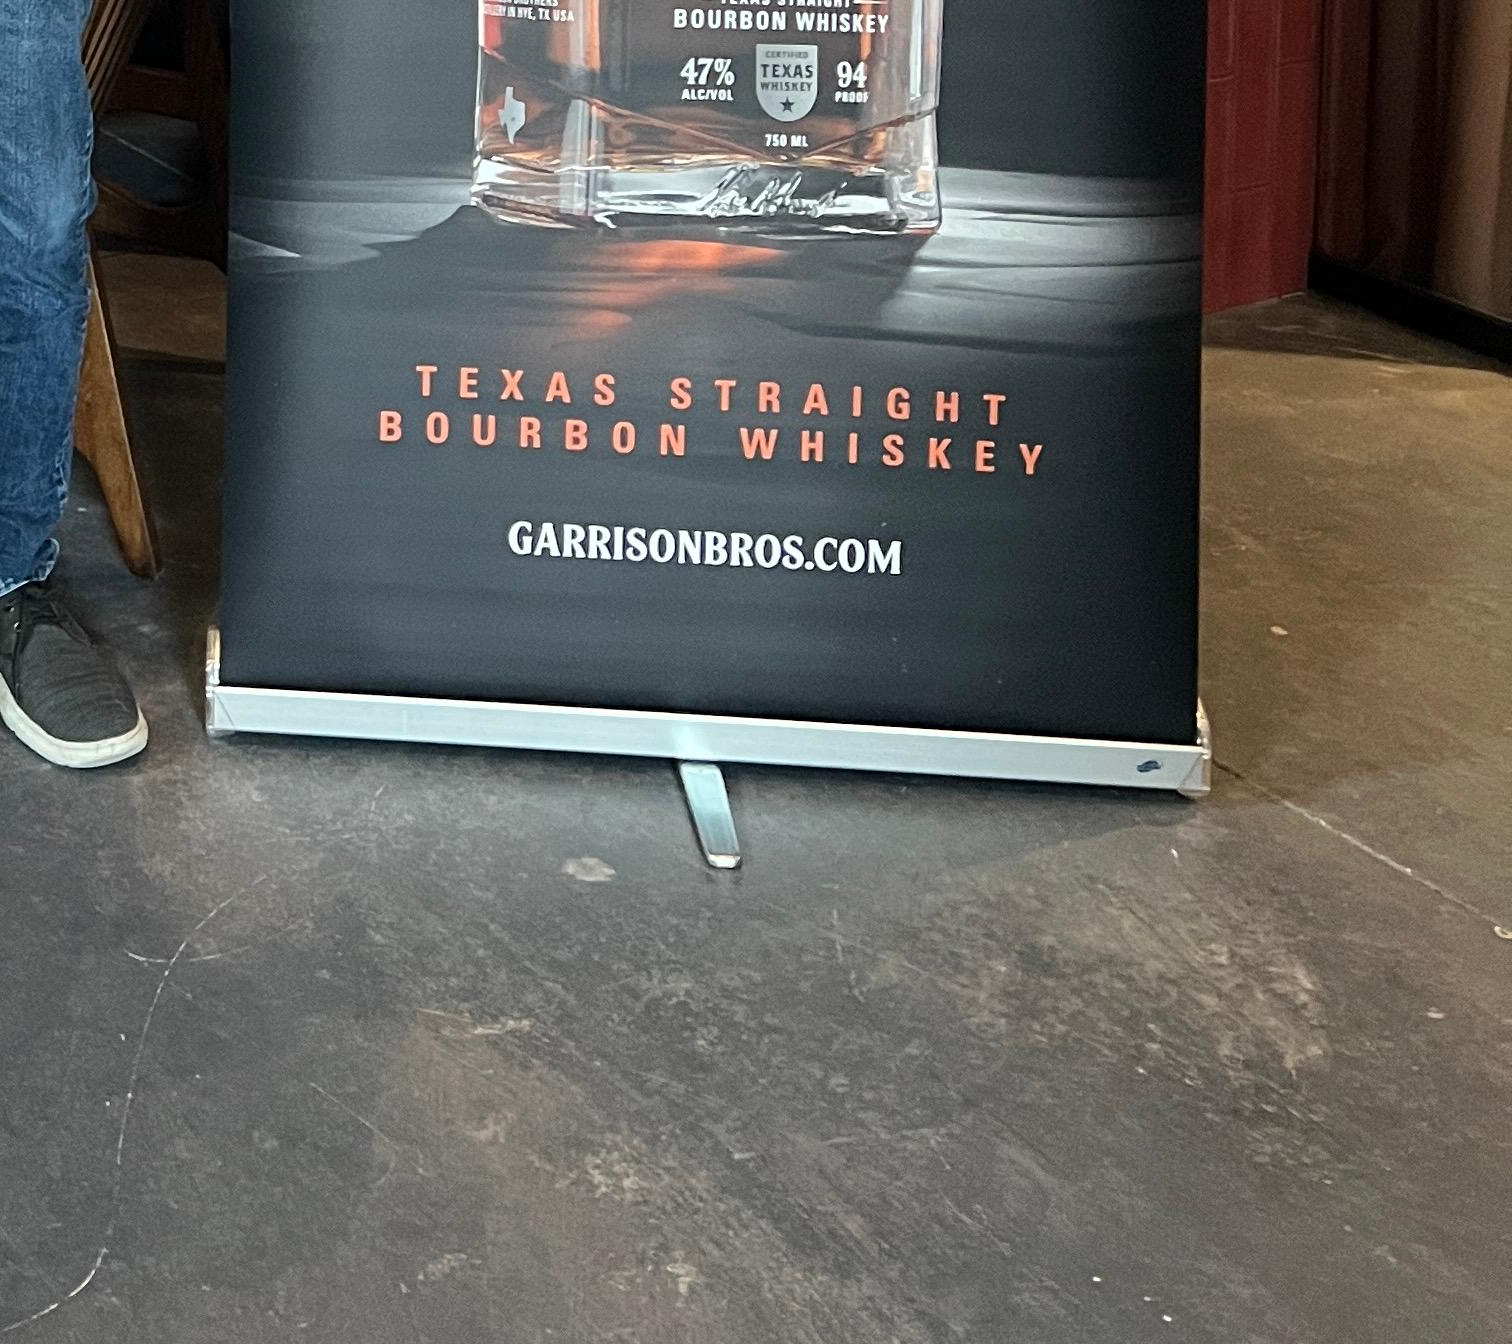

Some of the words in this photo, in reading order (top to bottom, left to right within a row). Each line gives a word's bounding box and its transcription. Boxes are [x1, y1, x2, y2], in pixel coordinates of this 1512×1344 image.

[552, 9, 575, 22] USA
[673, 9, 787, 31] BOURBON
[795, 11, 889, 34] WHISKEY
[765, 50, 809, 59] CERTIFIED
[680, 57, 735, 86] 47%
[760, 63, 814, 79] TEXAS
[836, 60, 868, 89] 94
[681, 88, 734, 101] ALC/VOL
[760, 81, 814, 92] WHISKEY
[834, 91, 869, 104] PROOF
[764, 133, 788, 147] 750
[790, 134, 809, 148] ML
[416, 365, 616, 406] TEXAS
[670, 377, 1006, 426] STRAIGHT
[379, 410, 686, 456] BOURBON
[740, 427, 1043, 476] WHISKEY
[508, 519, 902, 576] GARRISONBROS.COM
